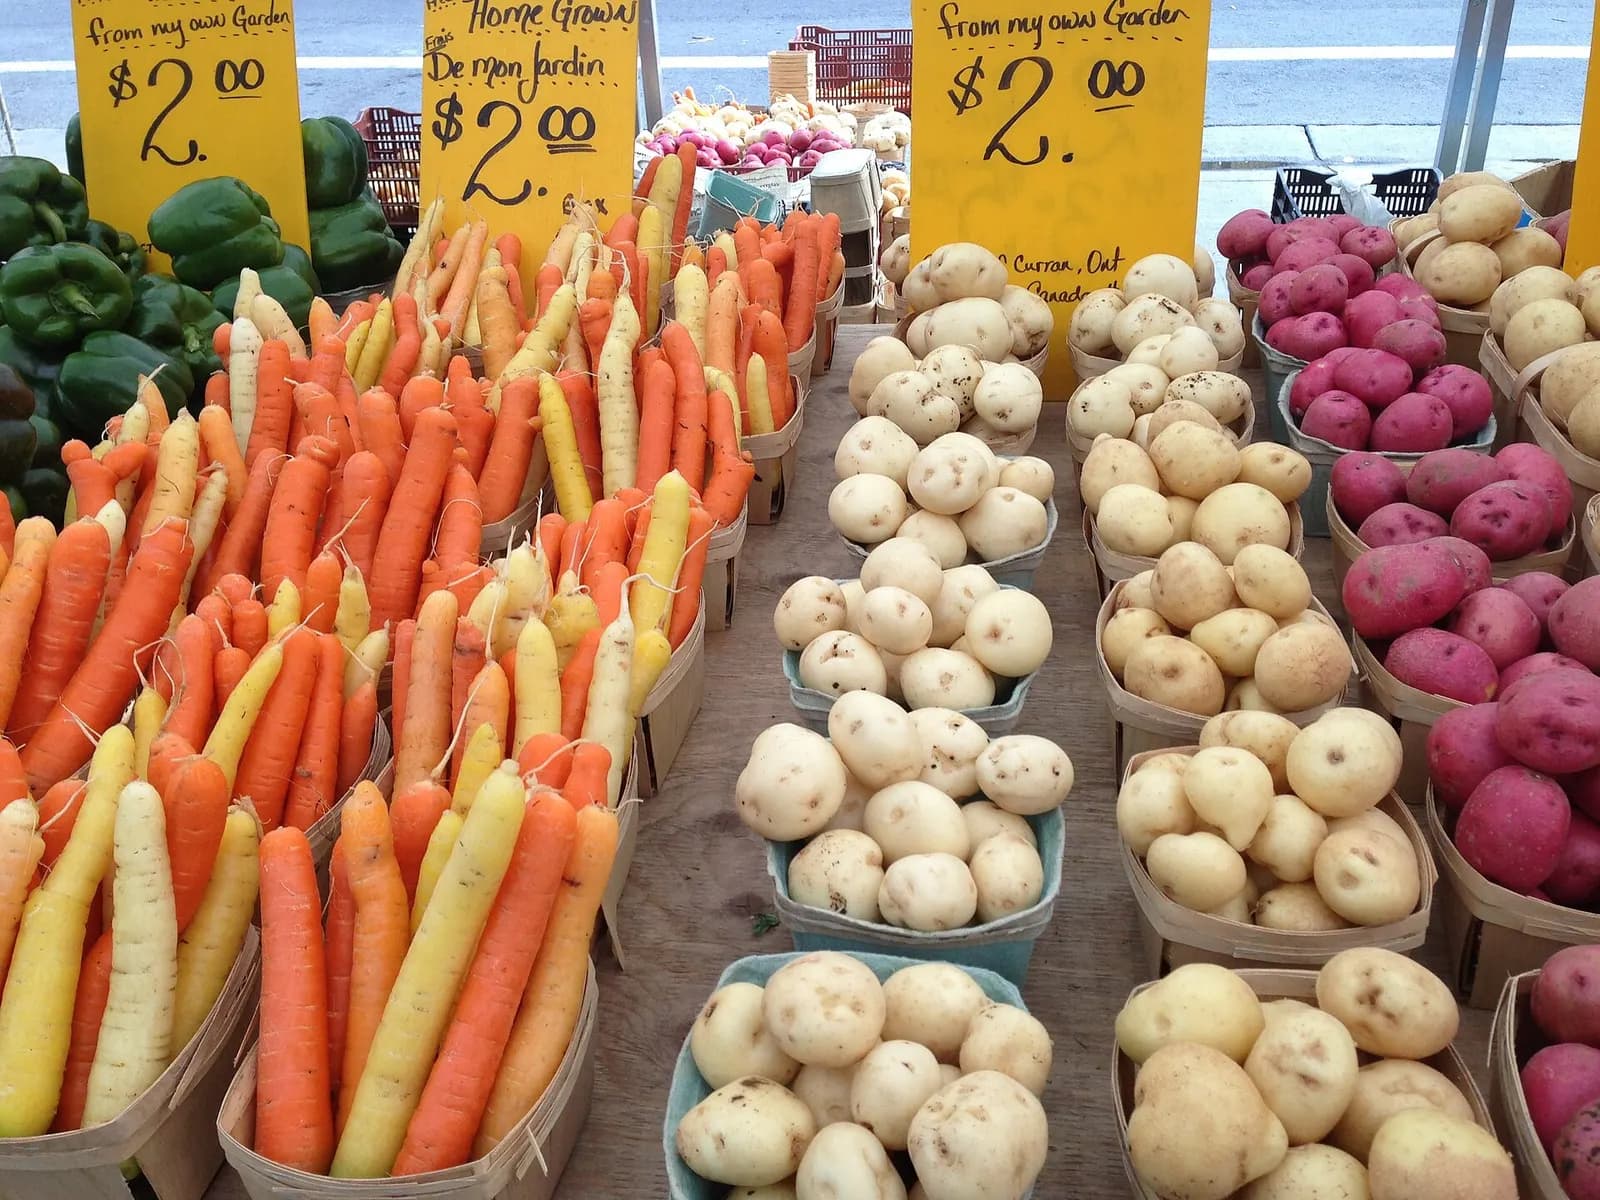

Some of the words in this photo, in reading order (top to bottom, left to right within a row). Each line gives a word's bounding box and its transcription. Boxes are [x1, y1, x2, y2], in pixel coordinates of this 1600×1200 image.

[86, 17, 143, 46] from
[151, 17, 185, 50] my
[232, 0, 291, 34] Garden
[463, 0, 544, 34] Home
[937, 2, 1000, 40] from
[1008, 15, 1043, 50] my
[1103, 0, 1190, 33] Garden
[423, 51, 465, 82] De
[472, 56, 522, 88] mon
[1087, 246, 1126, 274] Ont
